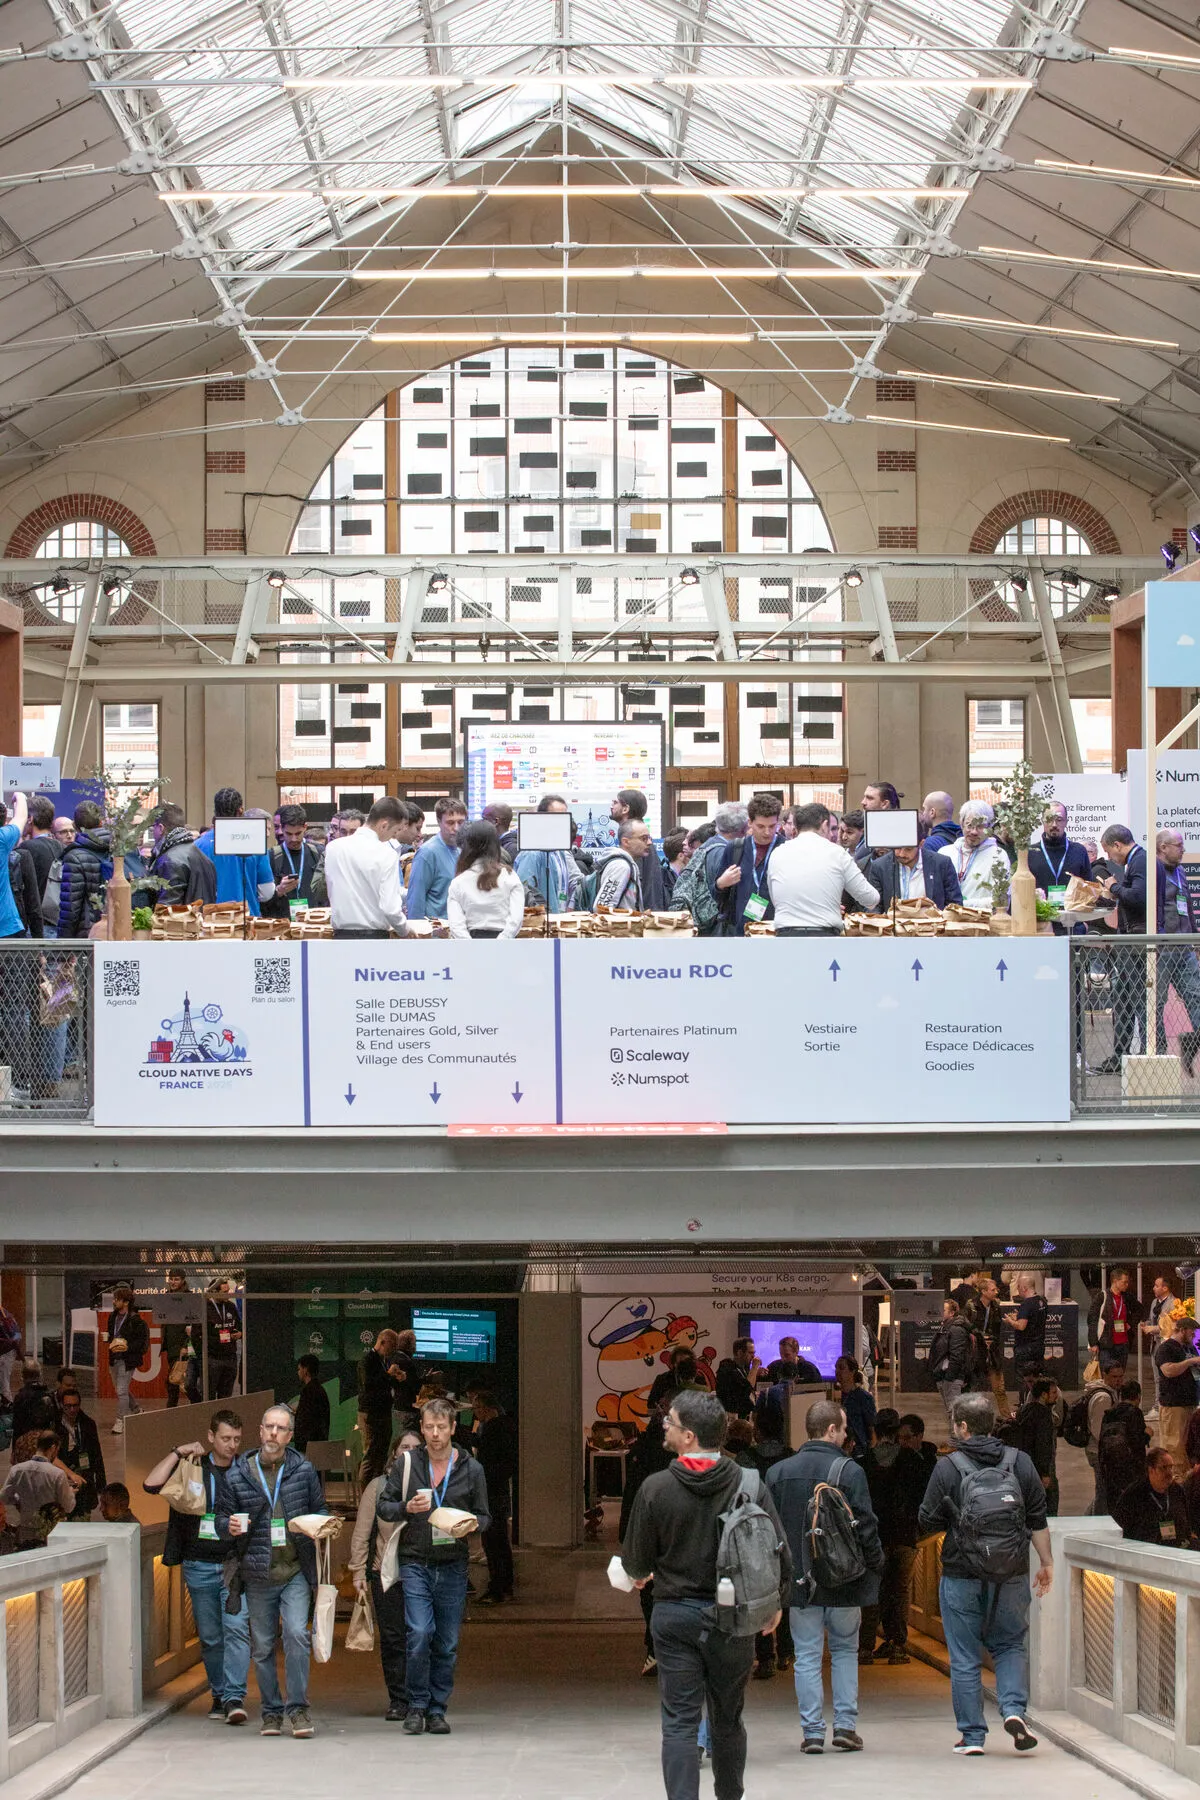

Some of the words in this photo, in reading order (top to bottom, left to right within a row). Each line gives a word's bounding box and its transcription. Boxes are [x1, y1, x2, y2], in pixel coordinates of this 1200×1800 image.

[1166, 770, 1200, 782] Num
[1075, 814, 1107, 824] gardant
[355, 968, 424, 981] Niveau
[433, 967, 453, 980] -1
[612, 966, 681, 979] Niveau
[690, 964, 732, 978] RDC
[356, 999, 385, 1009] Salle
[390, 998, 447, 1008] DEBUSSY
[356, 1013, 385, 1023] Salle
[390, 1012, 435, 1022] DUMAS
[357, 1027, 425, 1036] Partenaires
[429, 1026, 460, 1037] Gold,
[466, 1026, 498, 1035] Silver
[611, 1027, 679, 1036] Partenaires
[684, 1026, 737, 1035] Platinum
[805, 1024, 857, 1033] Vestiaire
[926, 1024, 1002, 1033] Restauration
[356, 1041, 365, 1050] &
[371, 1040, 393, 1049] End
[805, 1042, 840, 1051] Sortie
[926, 1041, 968, 1052] Espace
[973, 1041, 1034, 1051] Dédicaces
[357, 1055, 397, 1066] Village
[402, 1055, 423, 1064] des
[428, 1052, 516, 1063] Communautés
[627, 1049, 689, 1062] Scaleway
[926, 1061, 974, 1071] Goodies
[181, 1069, 220, 1077] NATIVE
[160, 1081, 203, 1089] FRANCE
[628, 1073, 689, 1086] Numspot
[712, 1273, 746, 1282] Secure
[750, 1275, 772, 1284] your
[776, 1274, 795, 1282] K8s
[798, 1274, 829, 1284] cargo.
[712, 1300, 727, 1309] for
[730, 1300, 792, 1309] Kubernetes.
